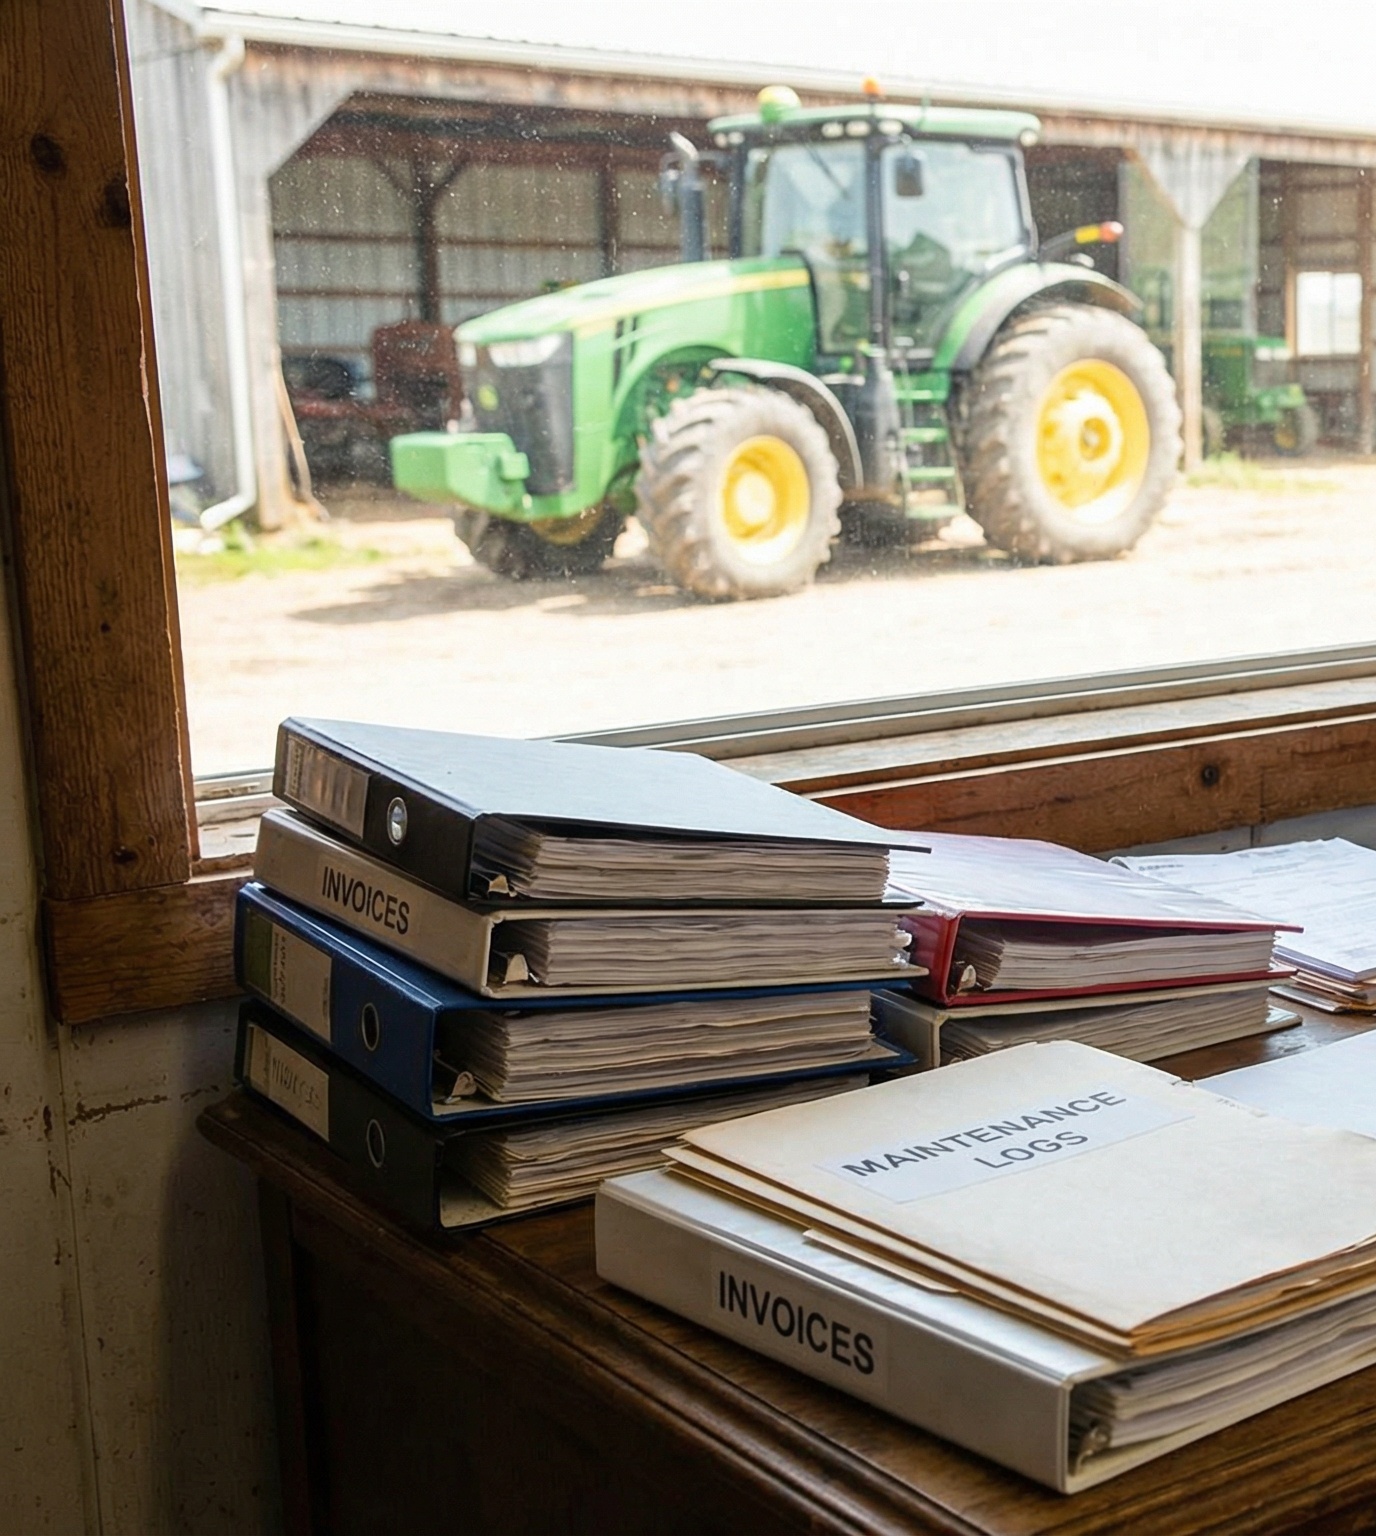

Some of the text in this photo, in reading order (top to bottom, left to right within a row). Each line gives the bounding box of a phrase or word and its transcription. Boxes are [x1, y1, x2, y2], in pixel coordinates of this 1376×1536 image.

[321, 866, 410, 935] INVOICES
[841, 1091, 1127, 1177] MAINTENANCE
[973, 1131, 1089, 1169] LOGS
[720, 1271, 875, 1375] INVOICES
